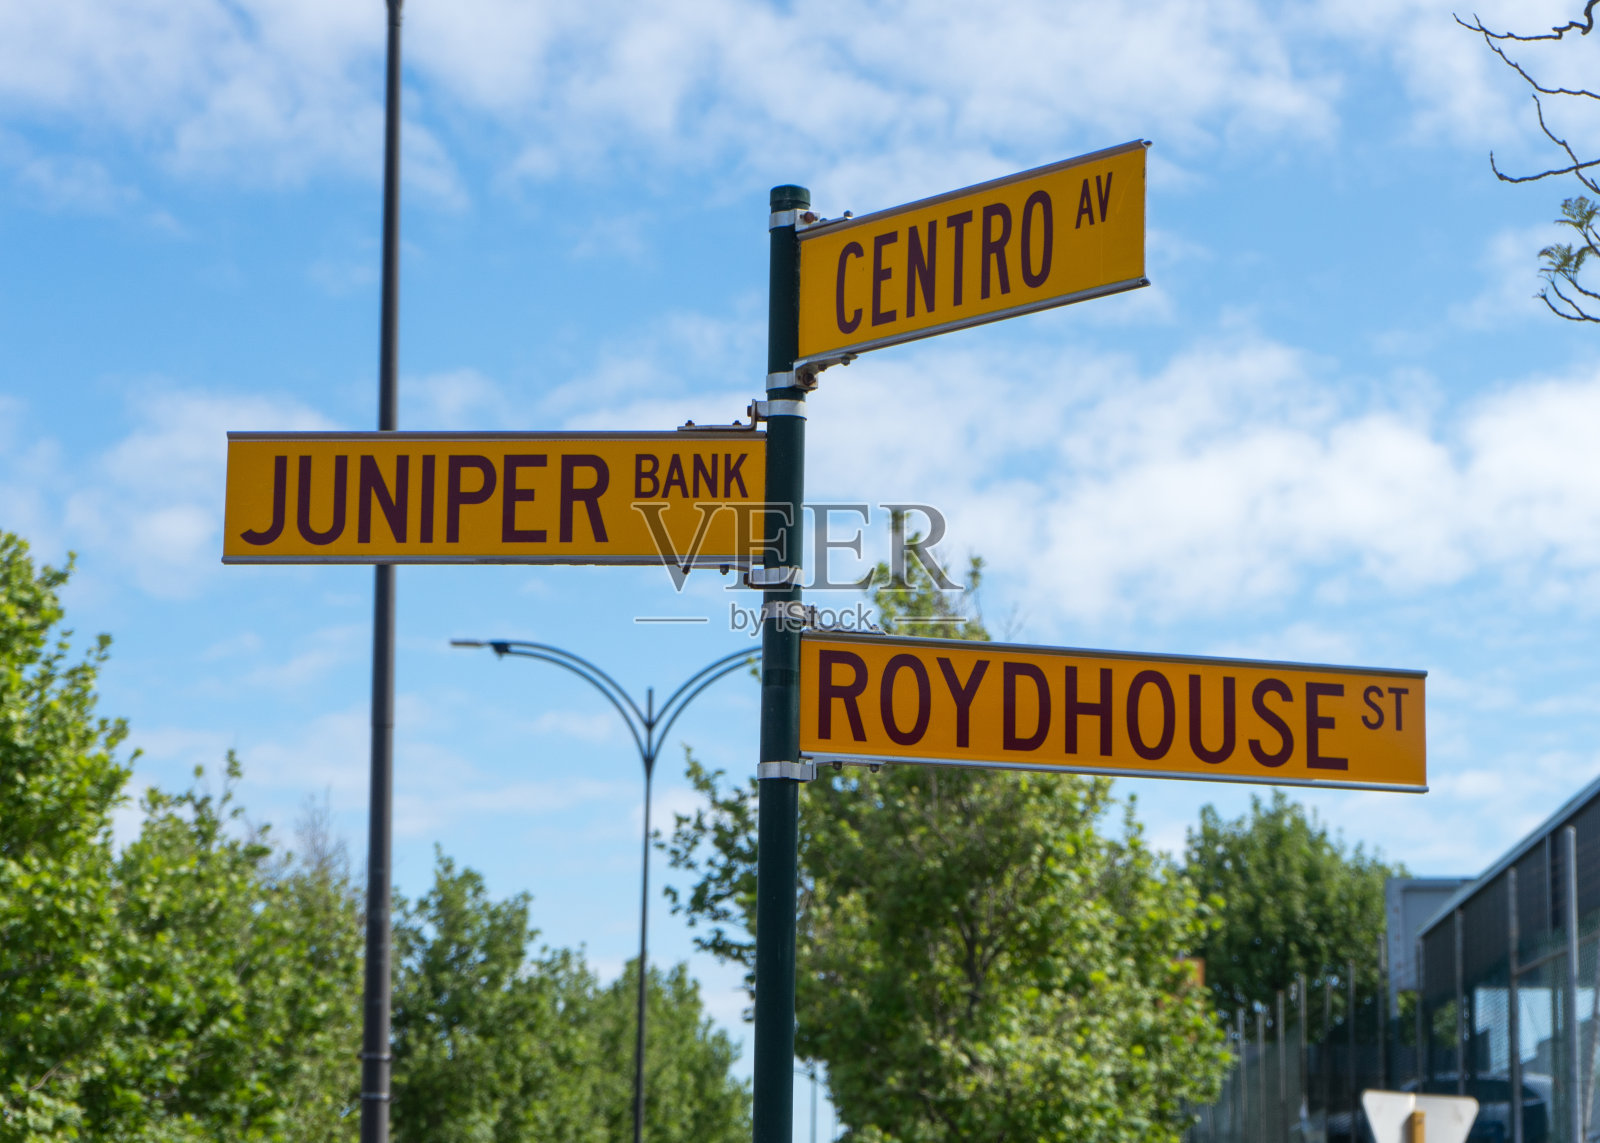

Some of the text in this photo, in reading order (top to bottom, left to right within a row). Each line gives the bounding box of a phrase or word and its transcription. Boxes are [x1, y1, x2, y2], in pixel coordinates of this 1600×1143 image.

[836, 171, 1114, 334] CENTRO AV
[240, 453, 749, 546] JUNIPER BANK
[818, 649, 1409, 771] ROYDHOUSE ST
